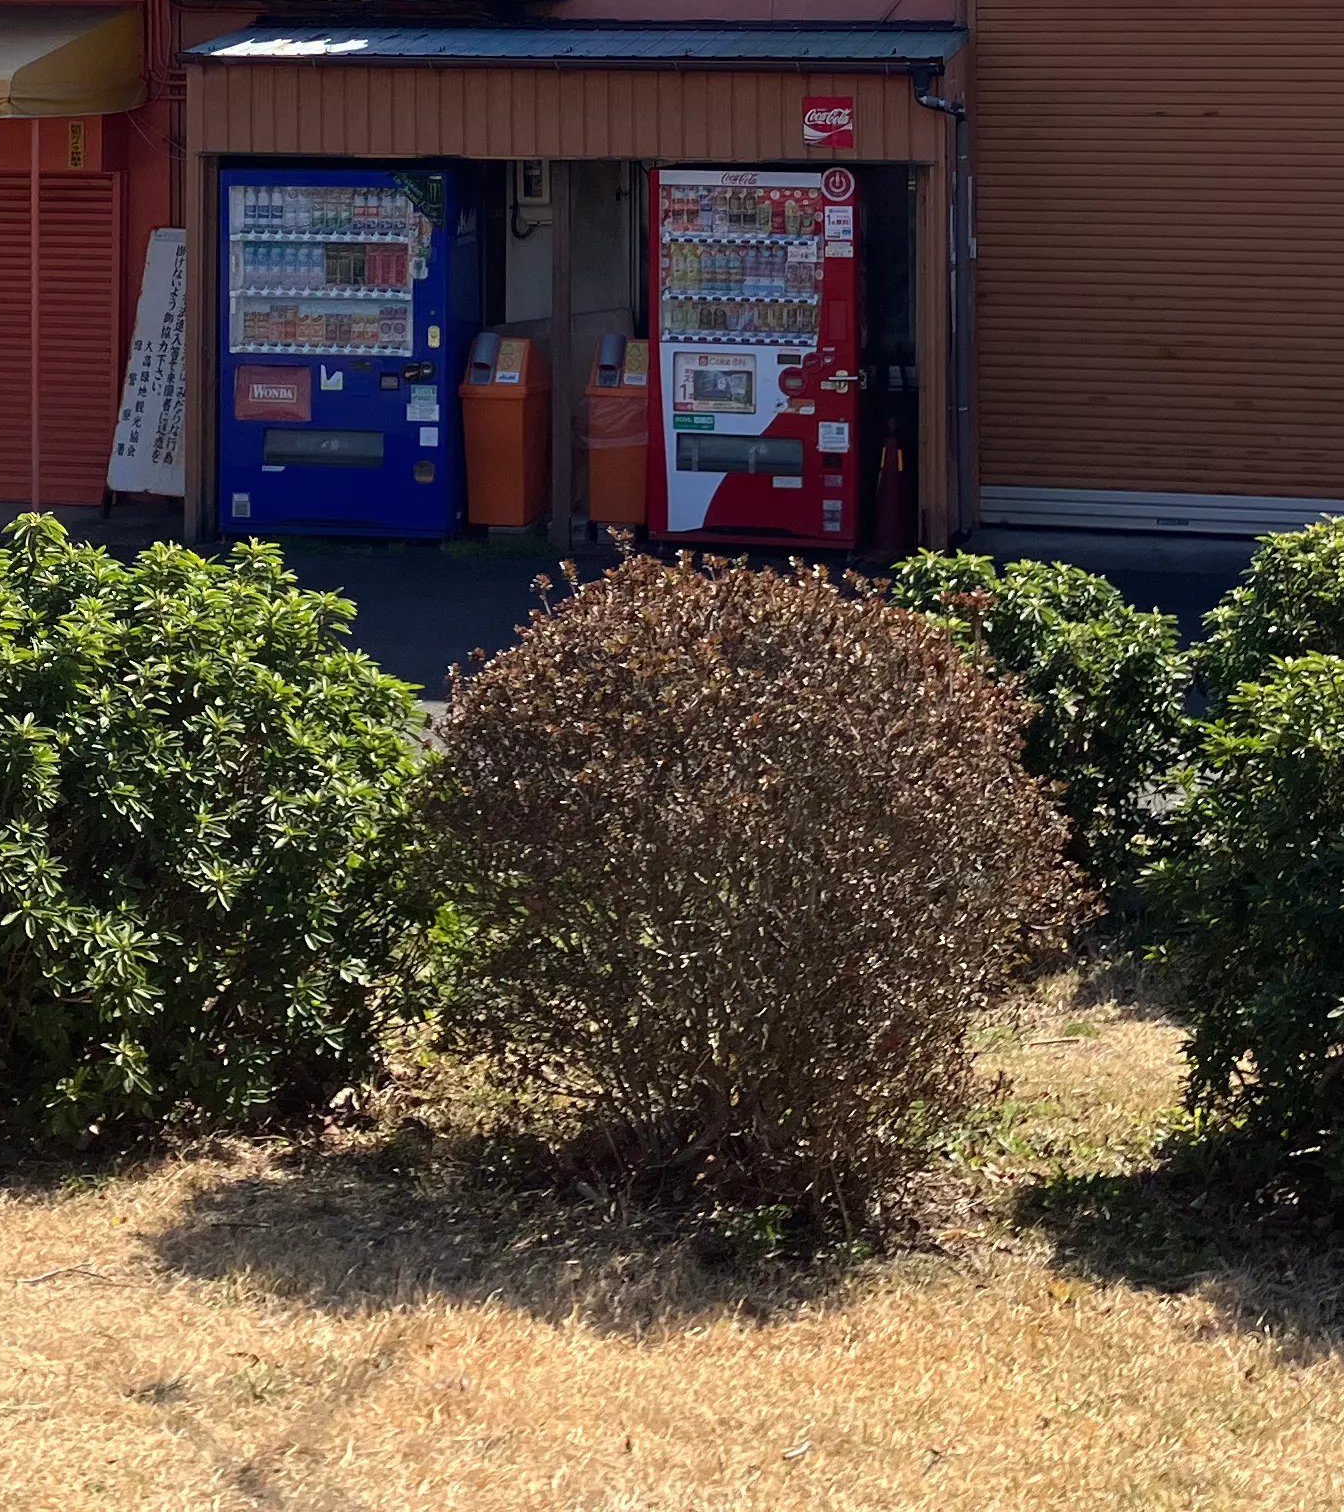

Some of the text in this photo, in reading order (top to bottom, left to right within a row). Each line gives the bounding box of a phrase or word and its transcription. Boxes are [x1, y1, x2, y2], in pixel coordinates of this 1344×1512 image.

[804, 108, 853, 125] Coca-Cola
[721, 172, 759, 184] Coca-Cola
[709, 357, 731, 366] Coke
[253, 384, 294, 400] WONDA
